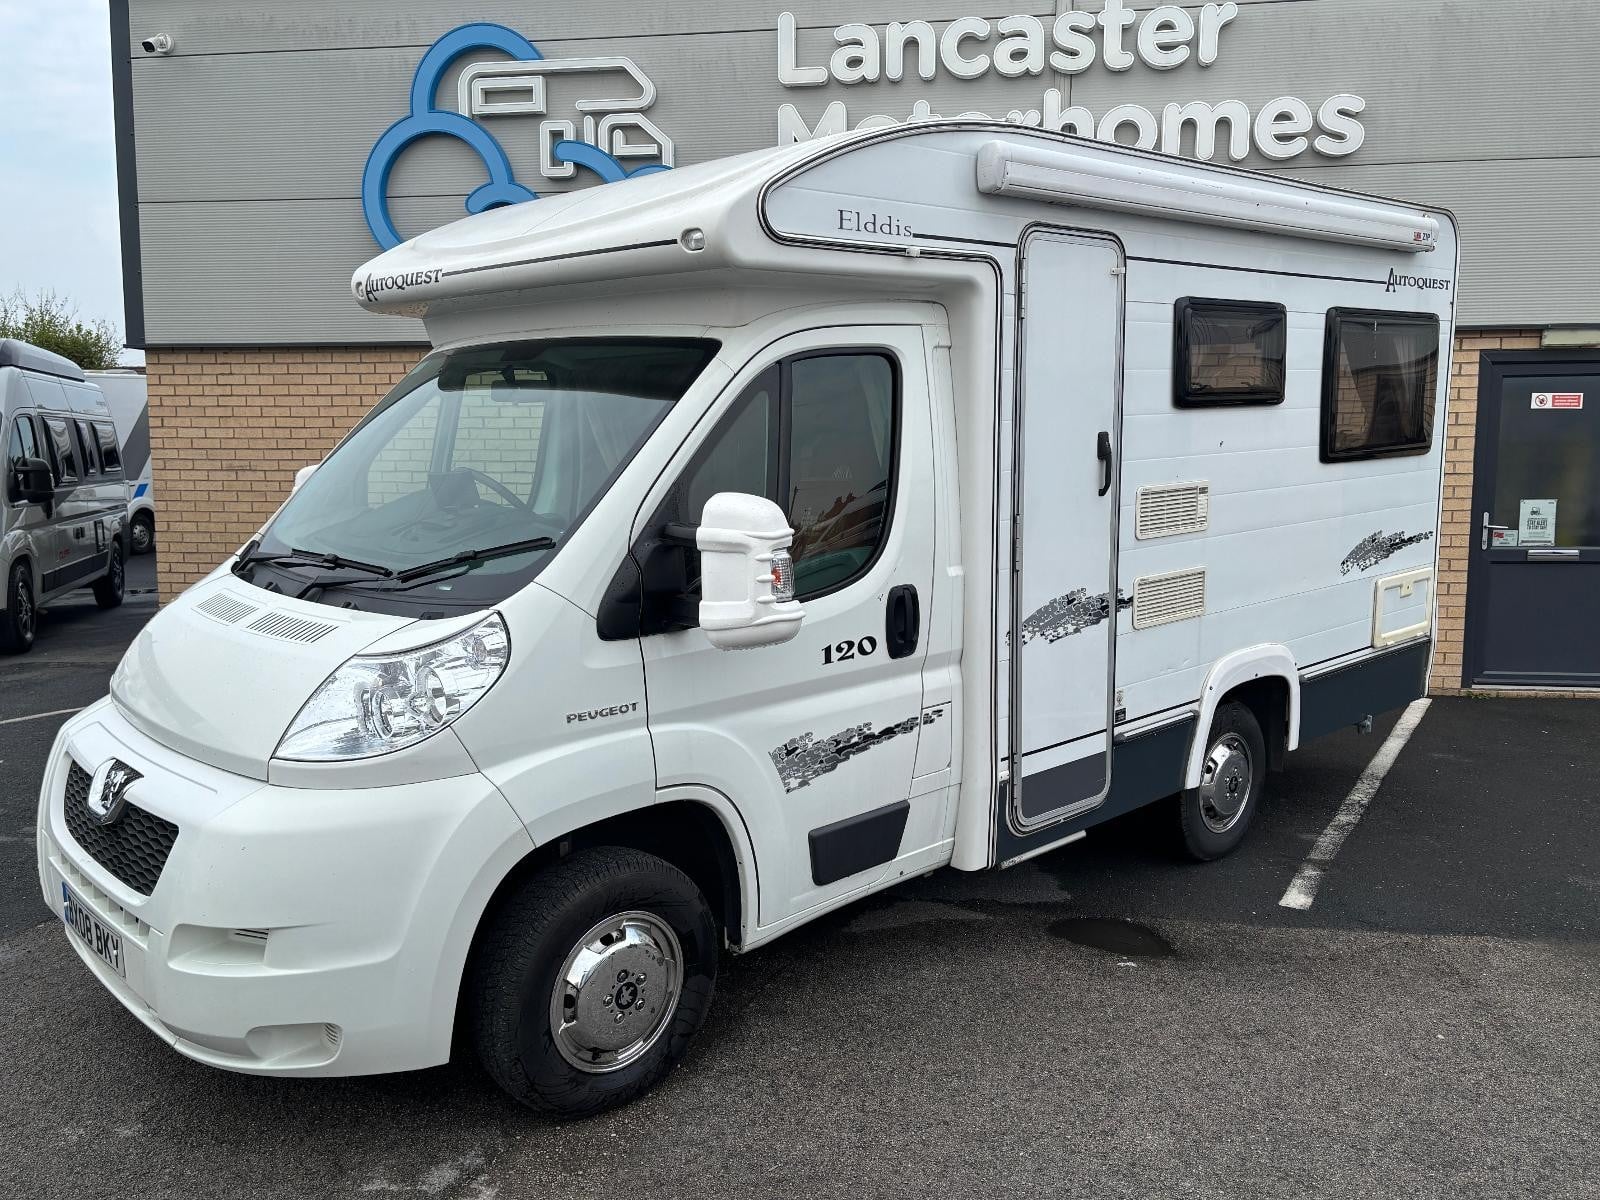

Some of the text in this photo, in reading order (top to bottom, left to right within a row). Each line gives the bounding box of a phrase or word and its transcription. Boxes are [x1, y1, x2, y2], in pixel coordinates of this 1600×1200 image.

[777, 0, 1238, 86] Lancaster
[777, 88, 1367, 161] Mhomes
[837, 209, 912, 237] Elddis
[365, 268, 442, 302] AUTOQUEST
[1385, 267, 1451, 293] AUTOQUEST
[821, 635, 878, 666] 120
[566, 701, 639, 723] PEUGEOT
[94, 921, 119, 969] BKY
